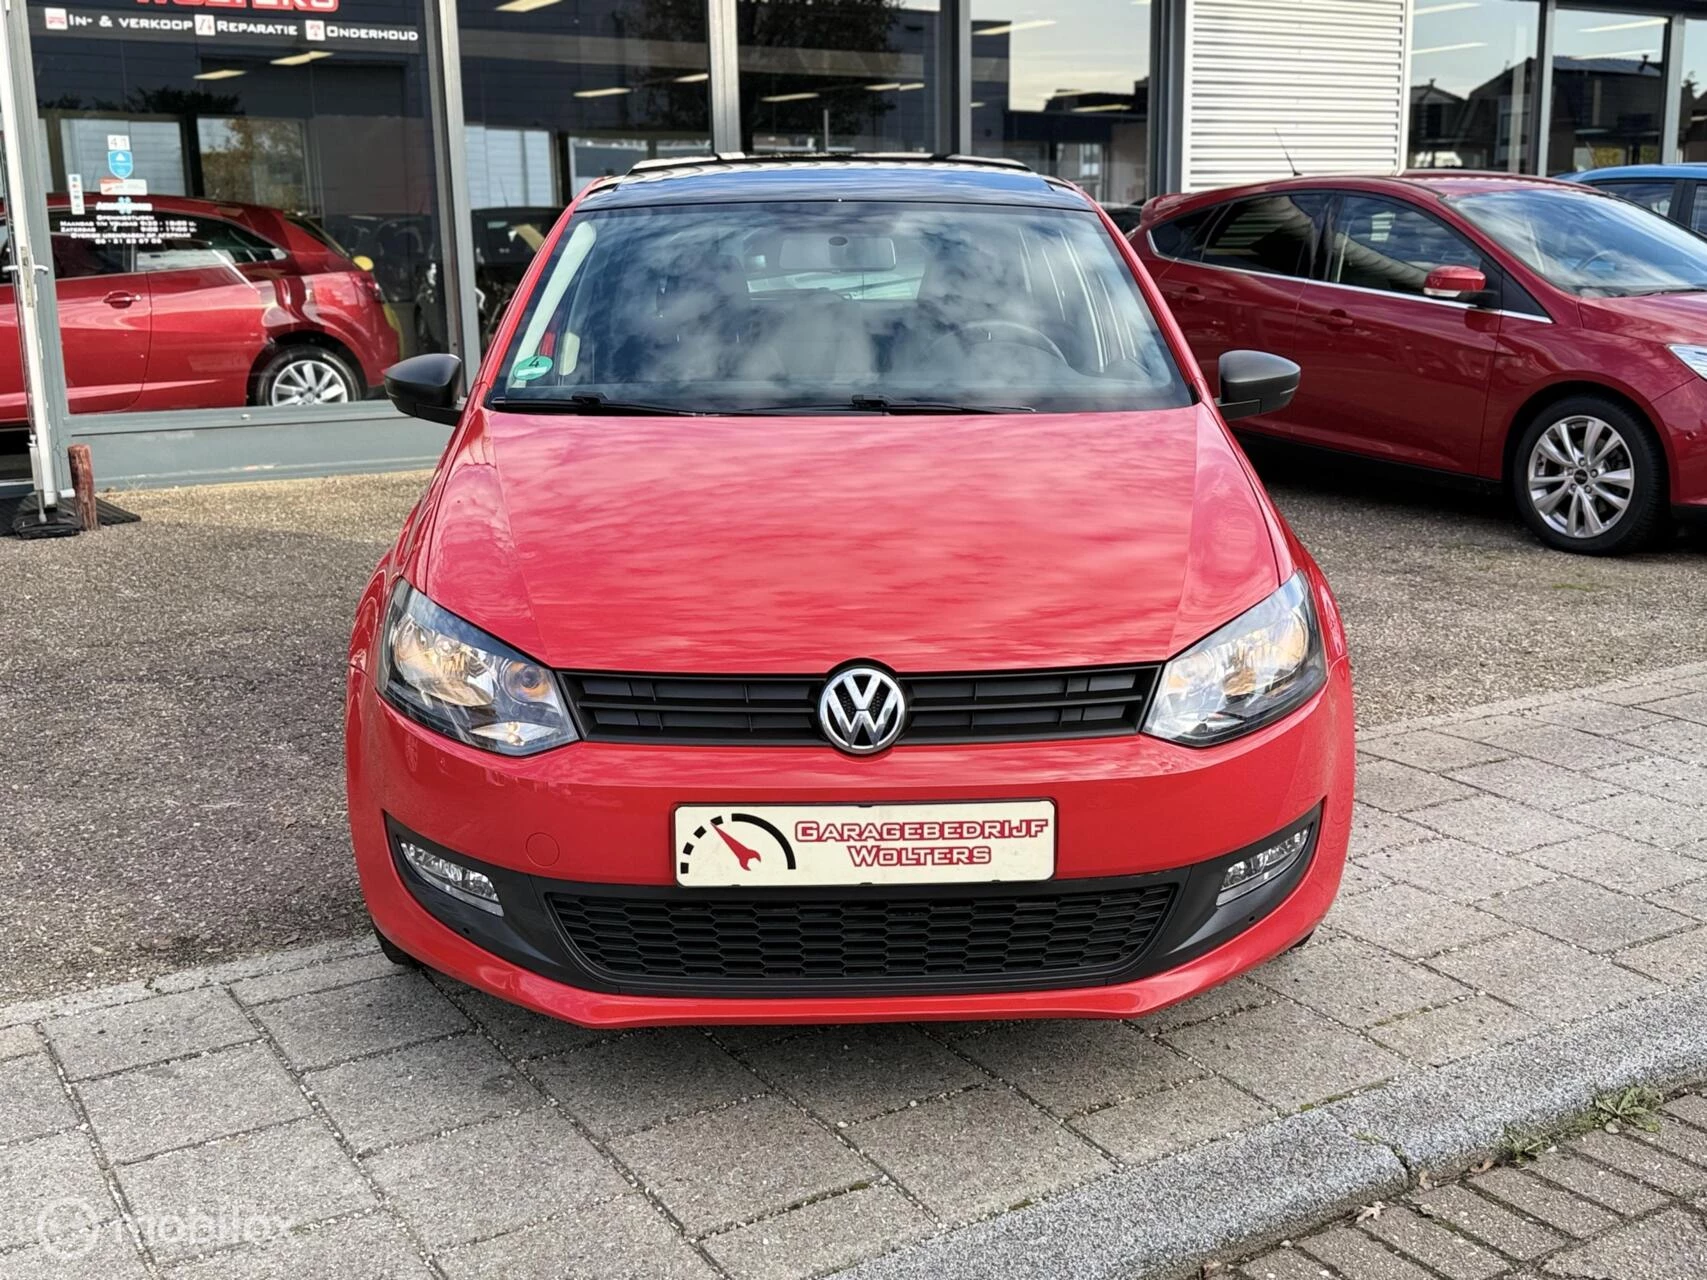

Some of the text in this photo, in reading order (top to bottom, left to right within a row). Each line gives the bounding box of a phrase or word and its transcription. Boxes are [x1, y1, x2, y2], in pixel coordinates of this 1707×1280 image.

[99, 15, 113, 28] &
[118, 17, 193, 31] VERKOOP
[217, 20, 298, 36] REPARATIE
[326, 25, 419, 41] ONDERHOUD
[528, 357, 539, 368] 4
[820, 668, 905, 754] VW
[795, 819, 1048, 842] GARAGEBEDRIJF
[846, 845, 991, 867] WOLTERS
